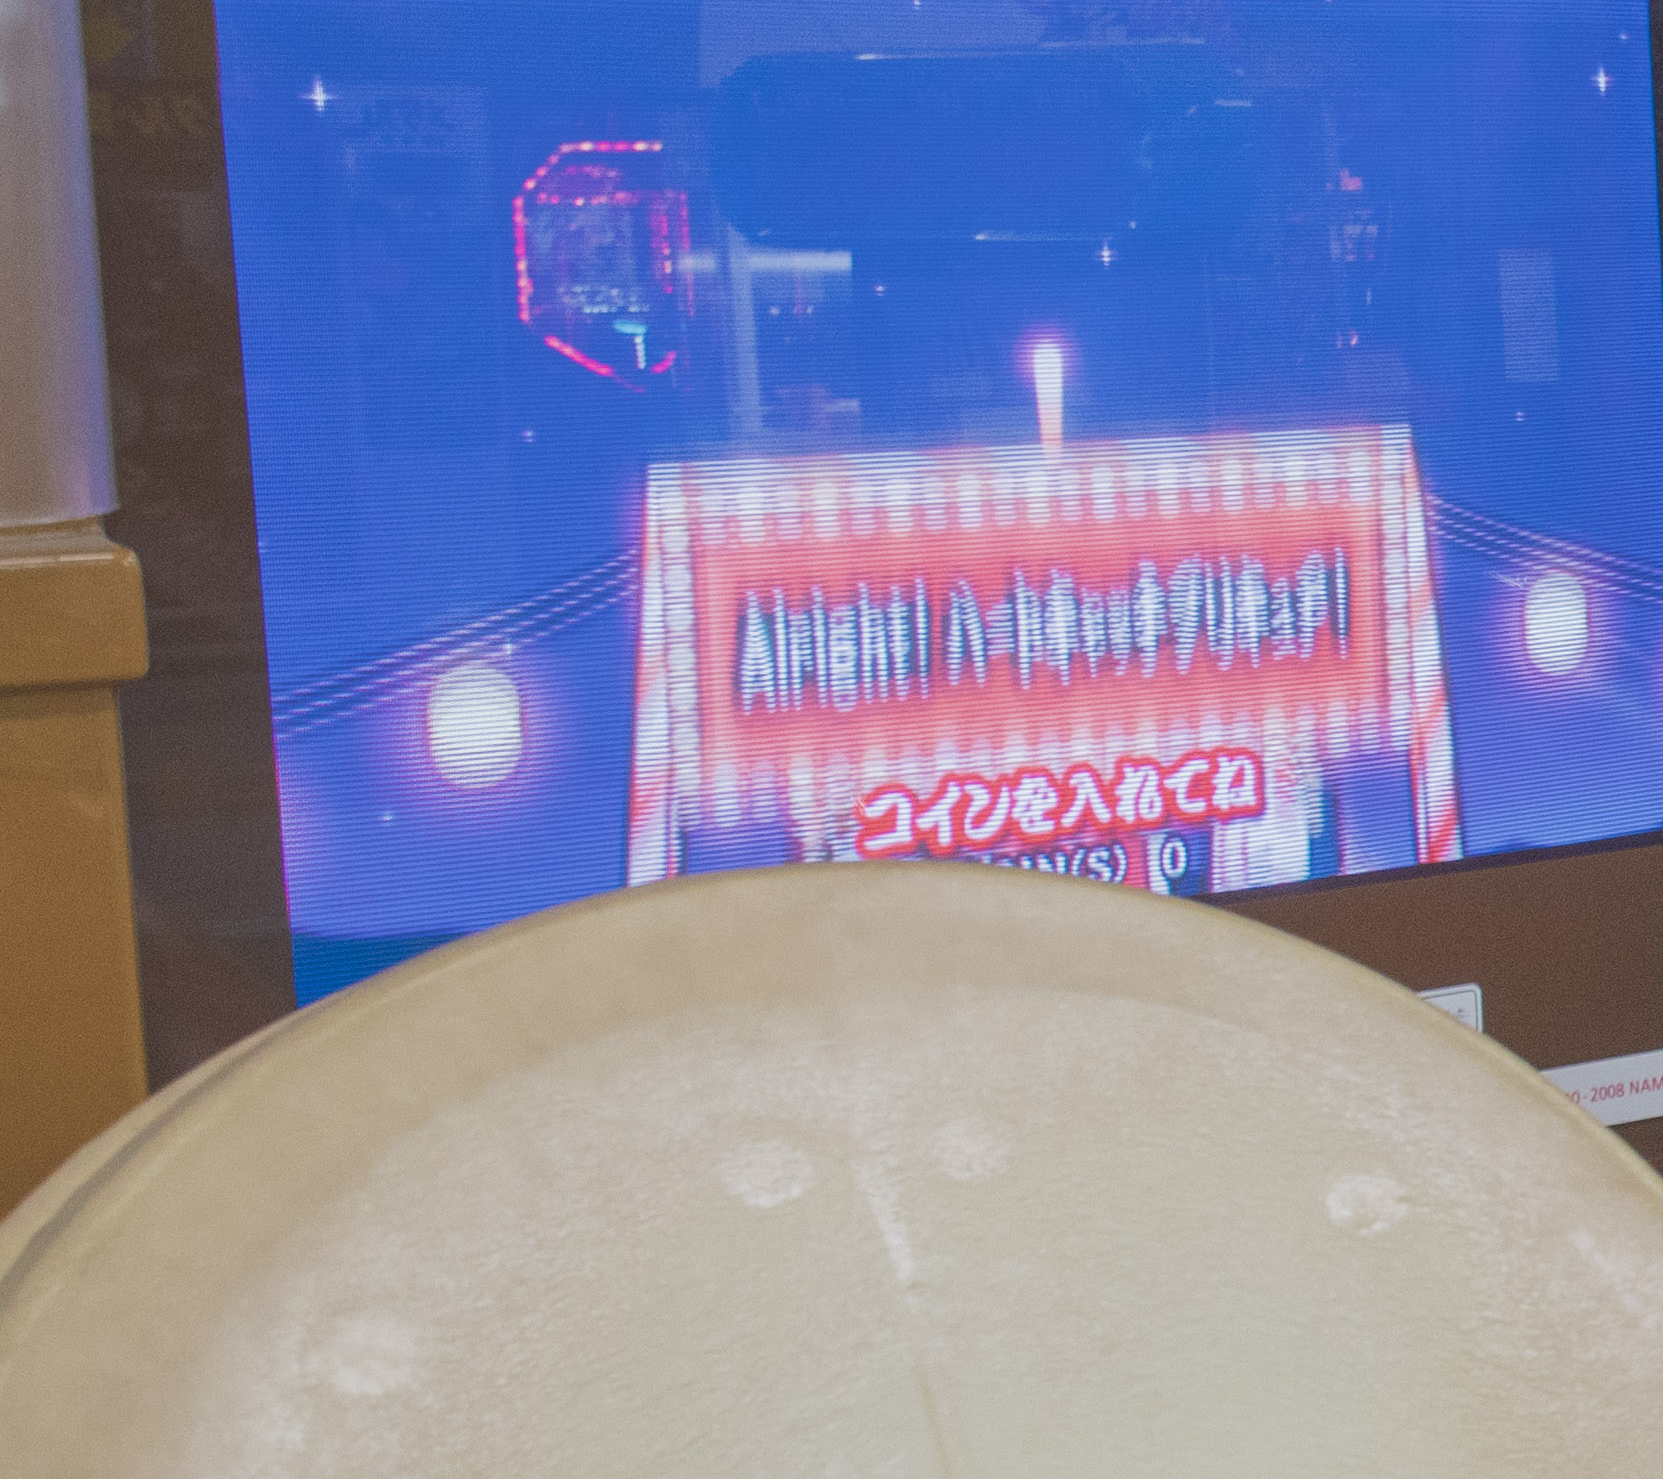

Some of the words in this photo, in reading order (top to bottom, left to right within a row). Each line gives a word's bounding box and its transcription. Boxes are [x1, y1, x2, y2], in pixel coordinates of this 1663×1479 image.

[862, 755, 1260, 849] コインを入れてね
[1159, 836, 1188, 880] 0
